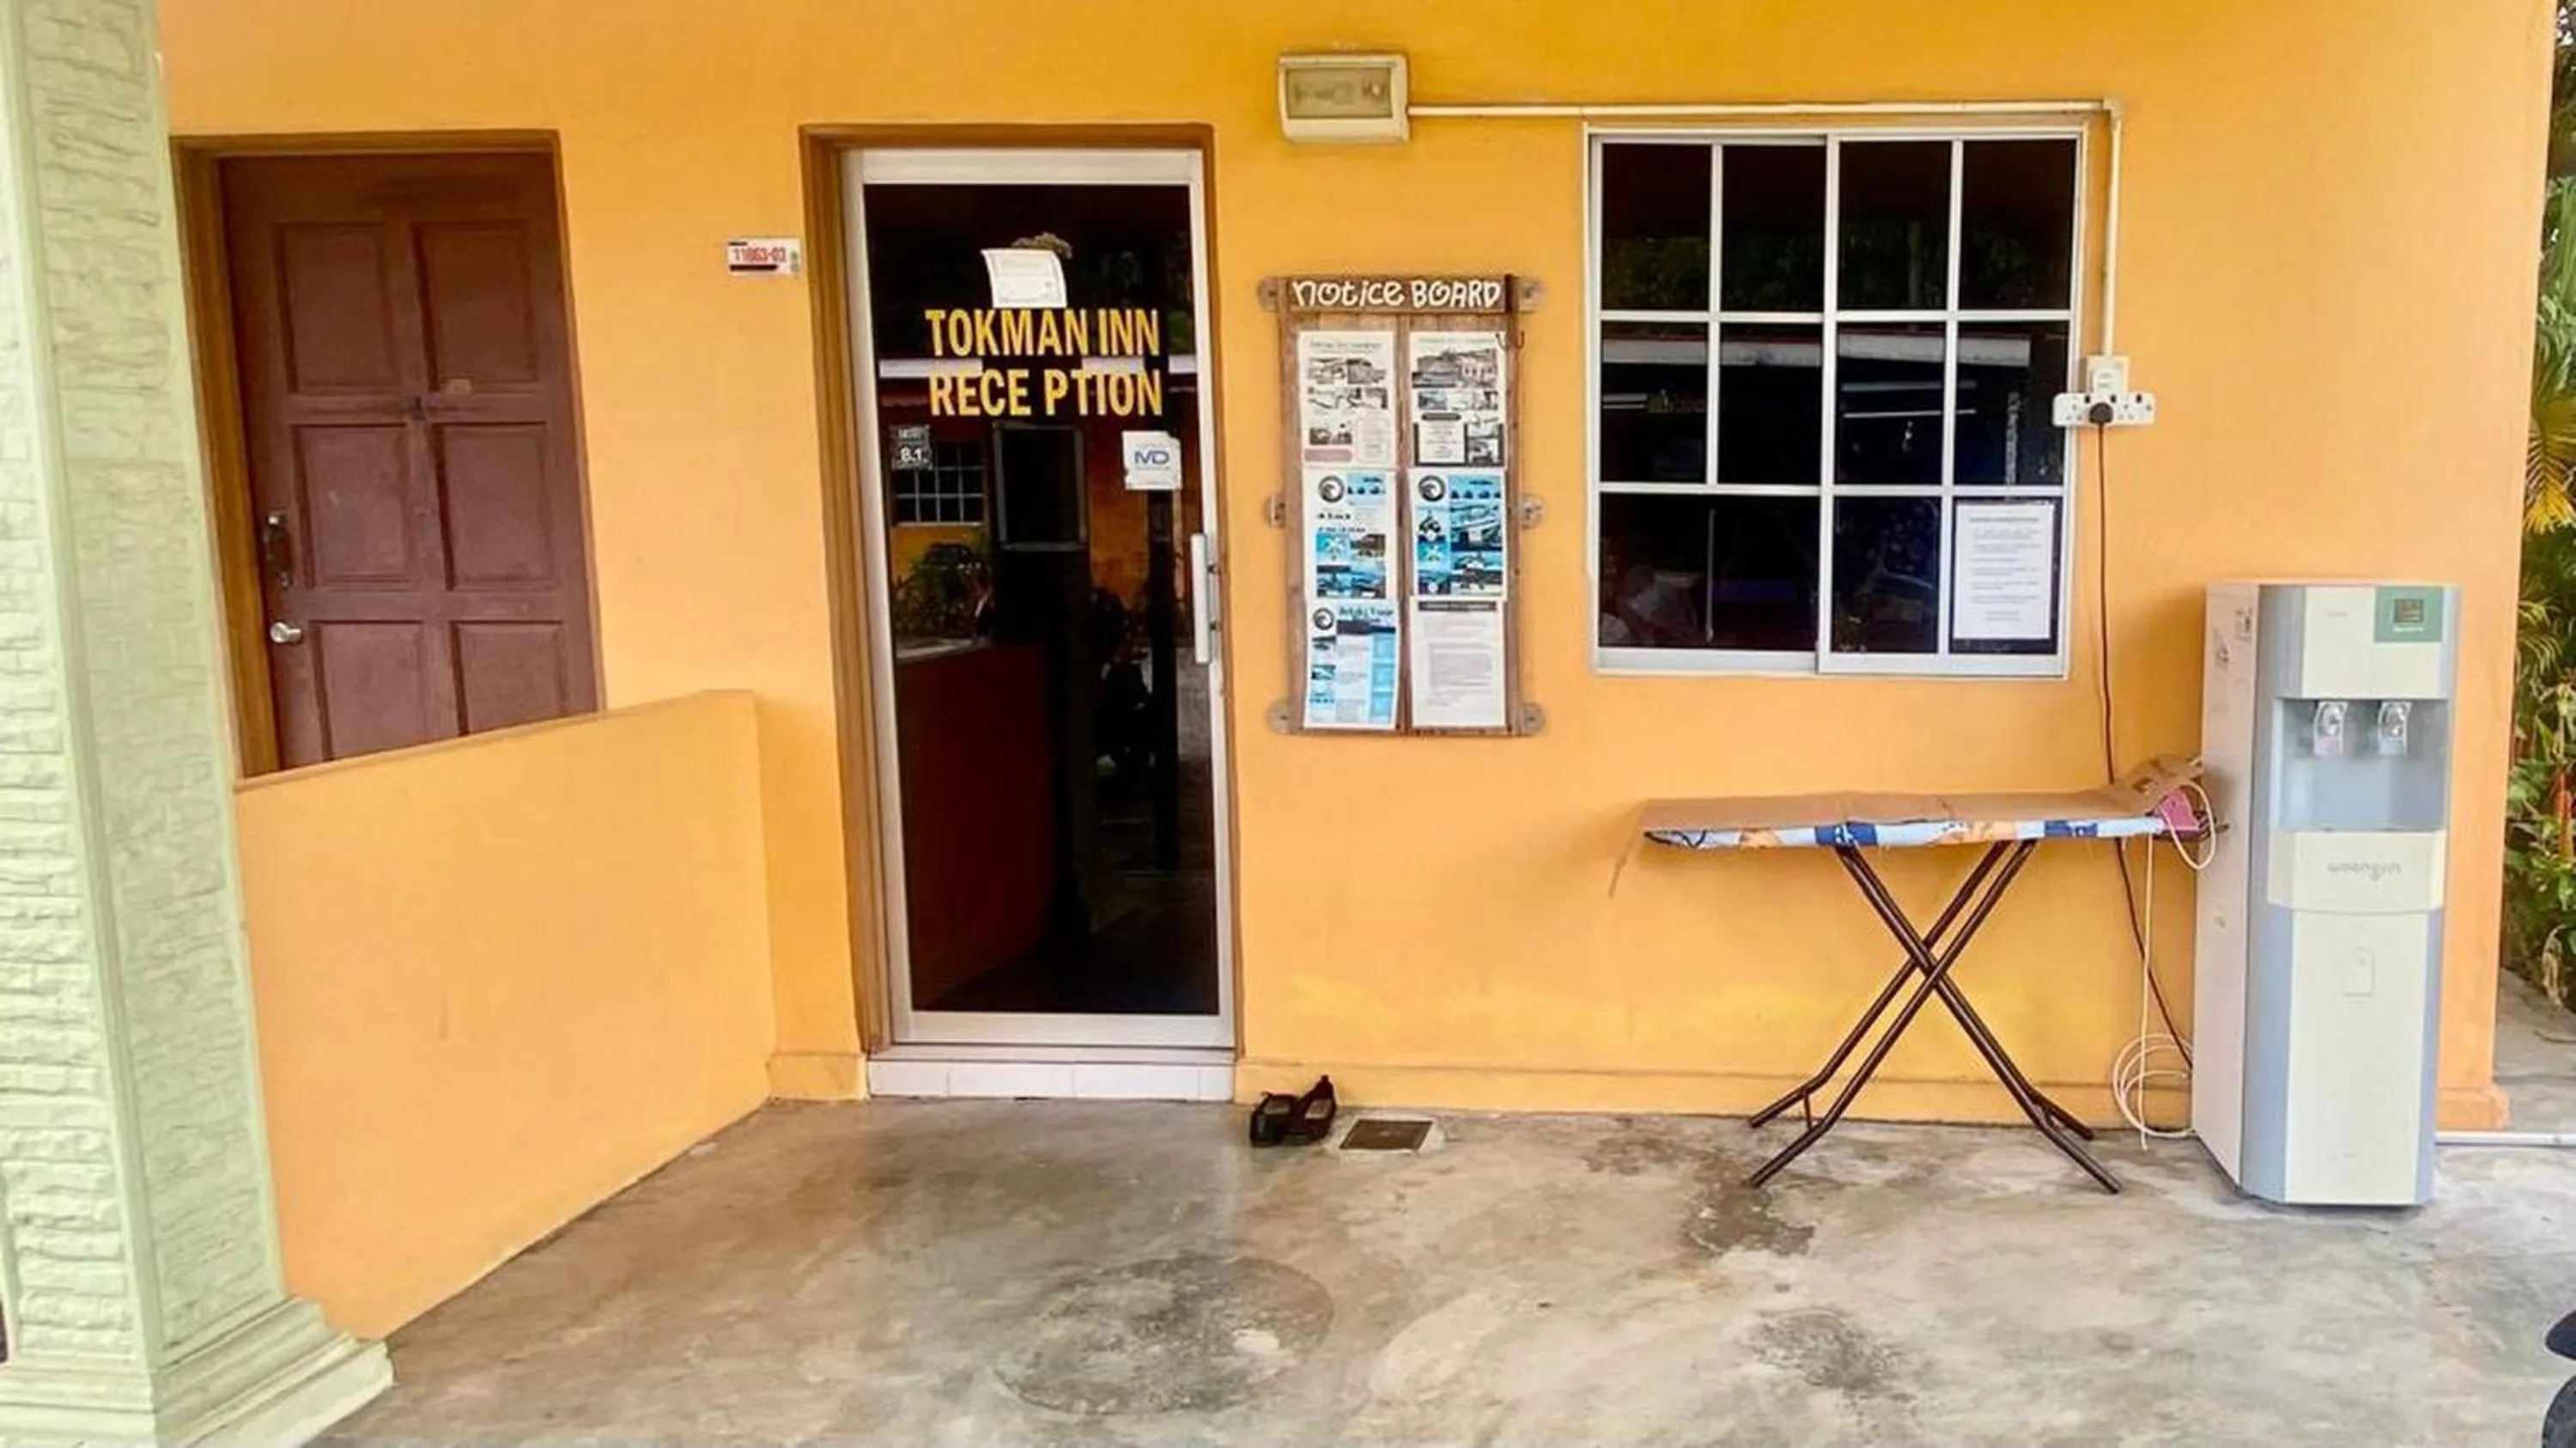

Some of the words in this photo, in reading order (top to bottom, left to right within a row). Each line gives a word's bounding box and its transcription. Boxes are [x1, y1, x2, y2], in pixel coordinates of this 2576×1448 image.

[1411, 279, 1501, 308] BOARD
[925, 308, 1088, 357] TOKMAN
[1097, 308, 1160, 357] INN
[928, 368, 1032, 417] RECE
[1043, 368, 1163, 417] PTION
